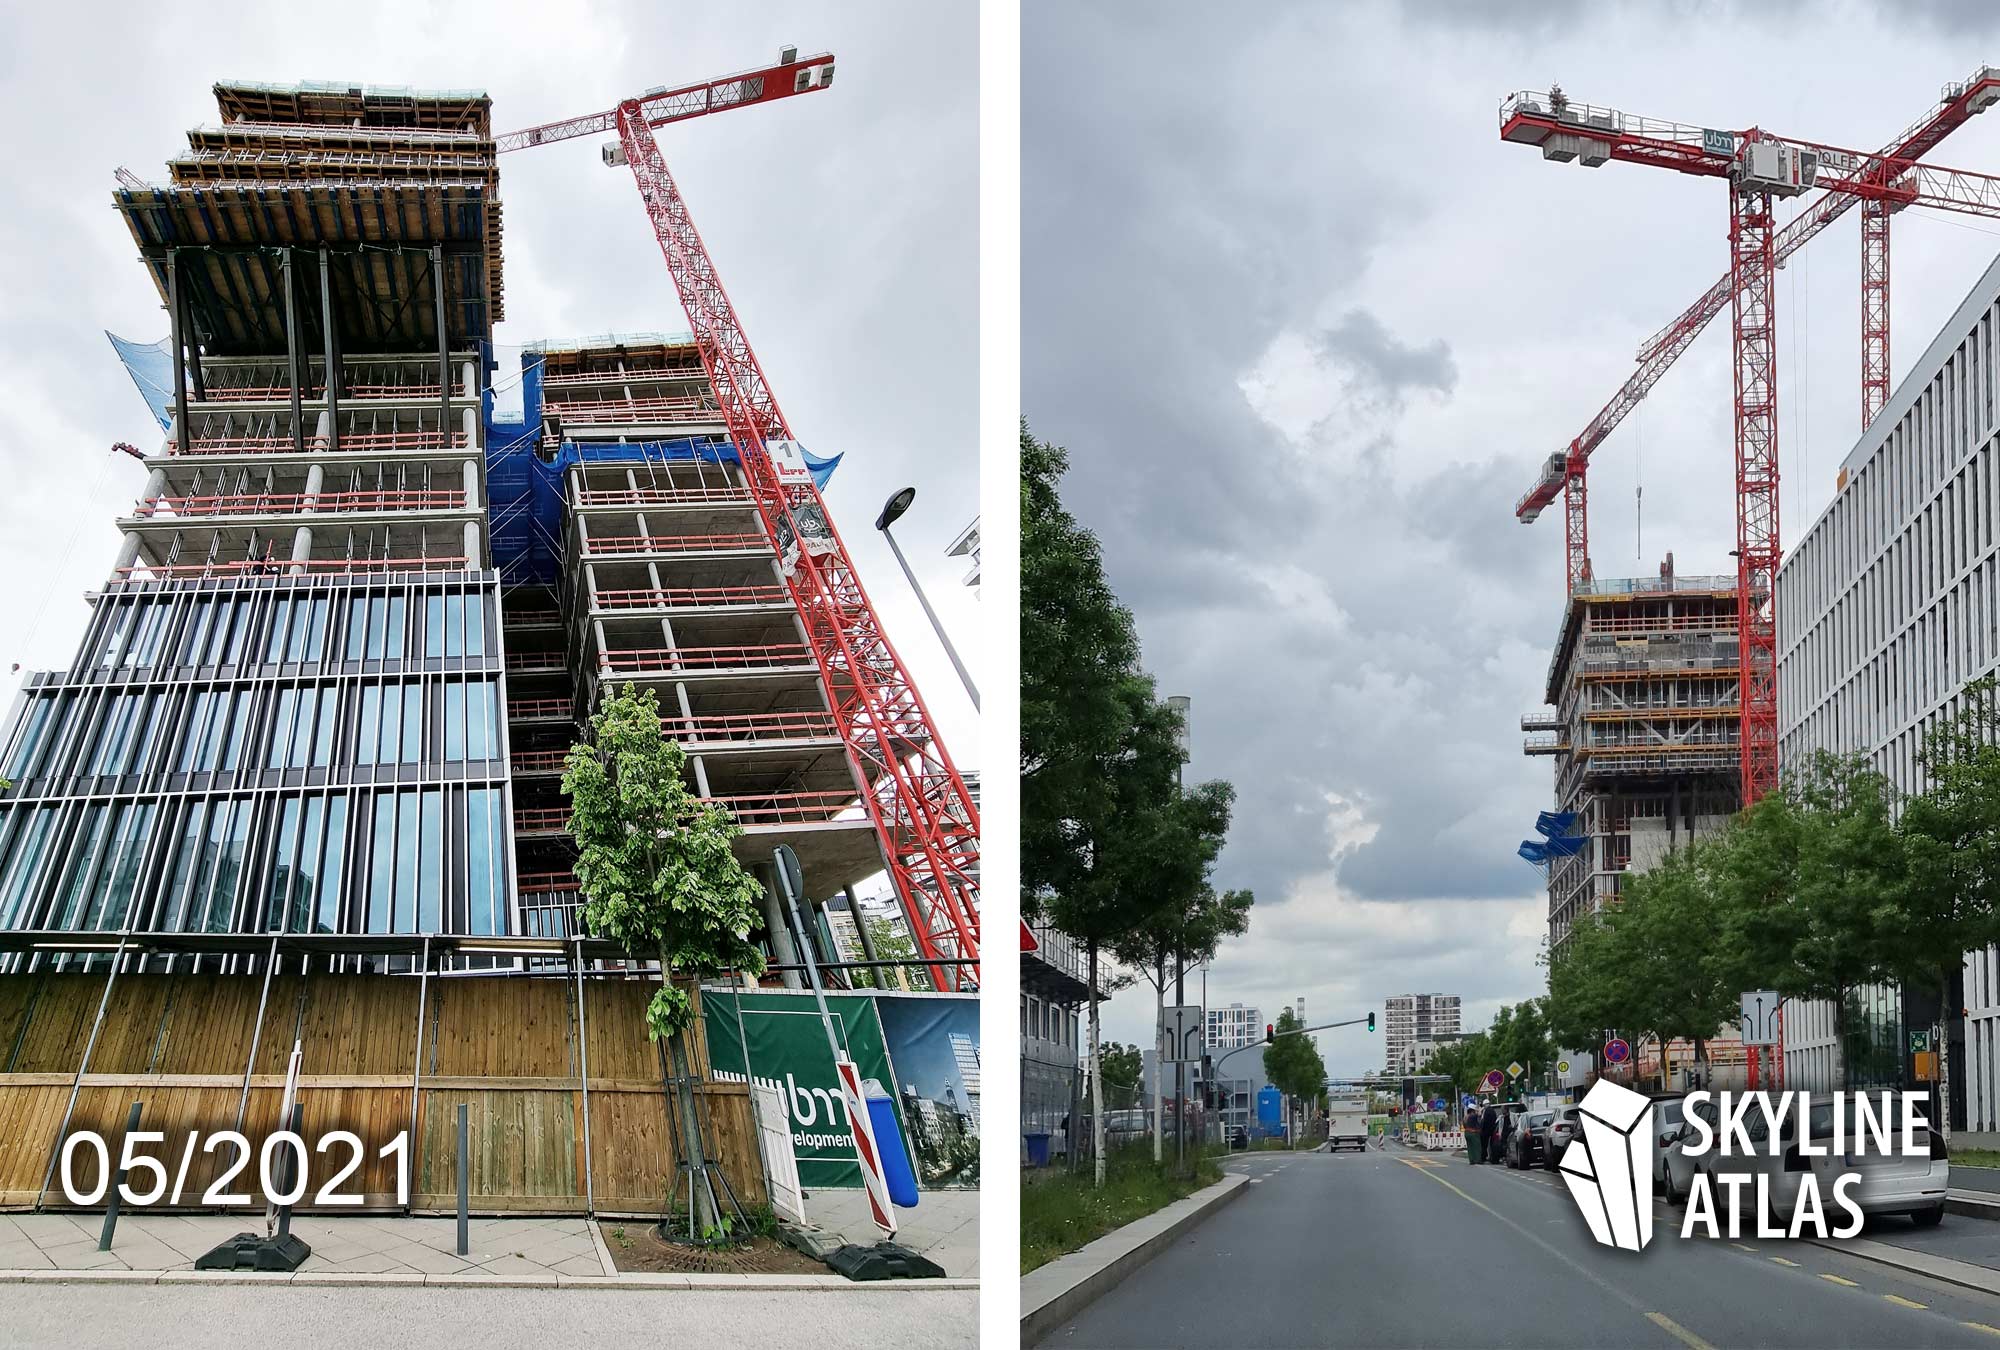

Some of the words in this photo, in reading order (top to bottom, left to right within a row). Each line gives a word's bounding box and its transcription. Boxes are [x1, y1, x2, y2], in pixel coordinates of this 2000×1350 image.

[1705, 131, 1733, 149] ubm
[1818, 151, 1858, 170] OLFF
[779, 443, 792, 457] 1
[784, 1073, 851, 1126] bm
